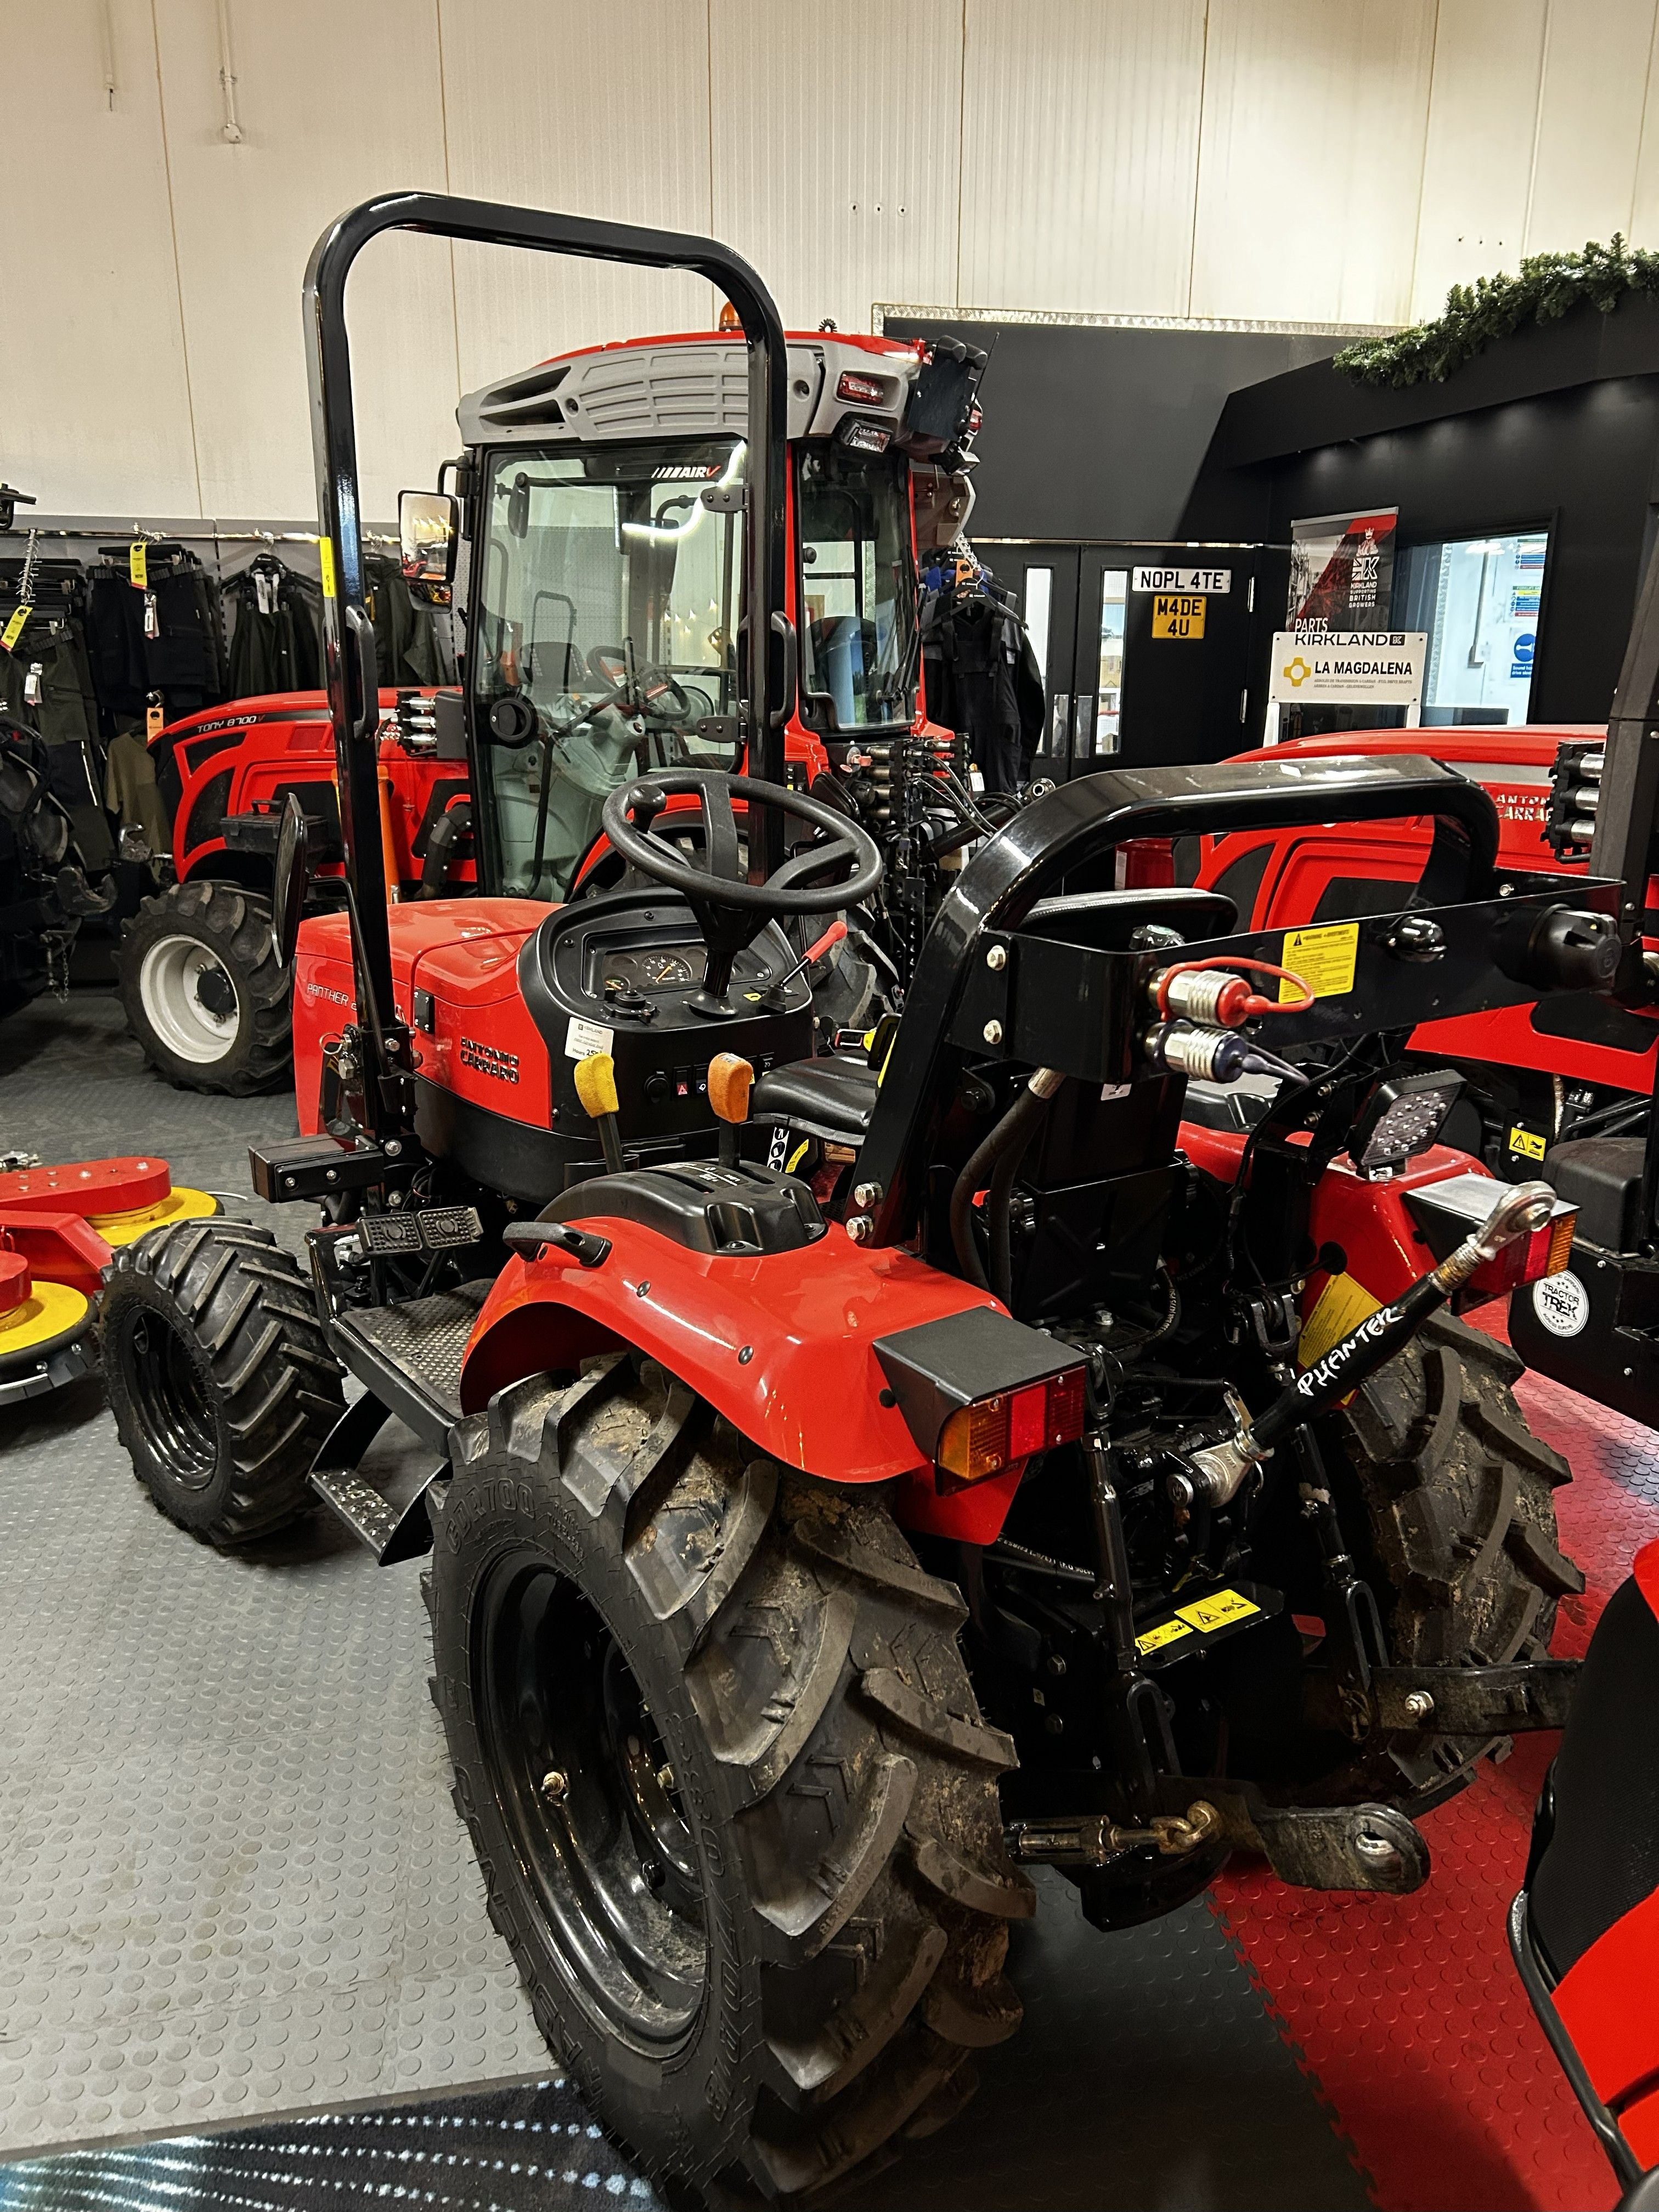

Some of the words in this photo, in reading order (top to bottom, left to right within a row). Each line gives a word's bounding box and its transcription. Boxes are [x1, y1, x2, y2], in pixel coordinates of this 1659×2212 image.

[1141, 571, 1184, 589] NOPL
[1190, 572, 1224, 589] 4TE
[1351, 581, 1378, 589] KIRKLAND
[1157, 599, 1203, 616] M4DE
[1167, 619, 1190, 636] 4U
[1295, 618, 1328, 633] PARTS
[1295, 634, 1387, 646] KIRKLAND
[1315, 662, 1330, 674] LA
[1334, 662, 1412, 675] MAGDALENA
[198, 720, 224, 733] TONY
[227, 715, 257, 726] 8700
[307, 983, 349, 1007] PANTHER
[1543, 1283, 1579, 1306] TRACTOR
[1542, 1291, 1578, 1321] TREK
